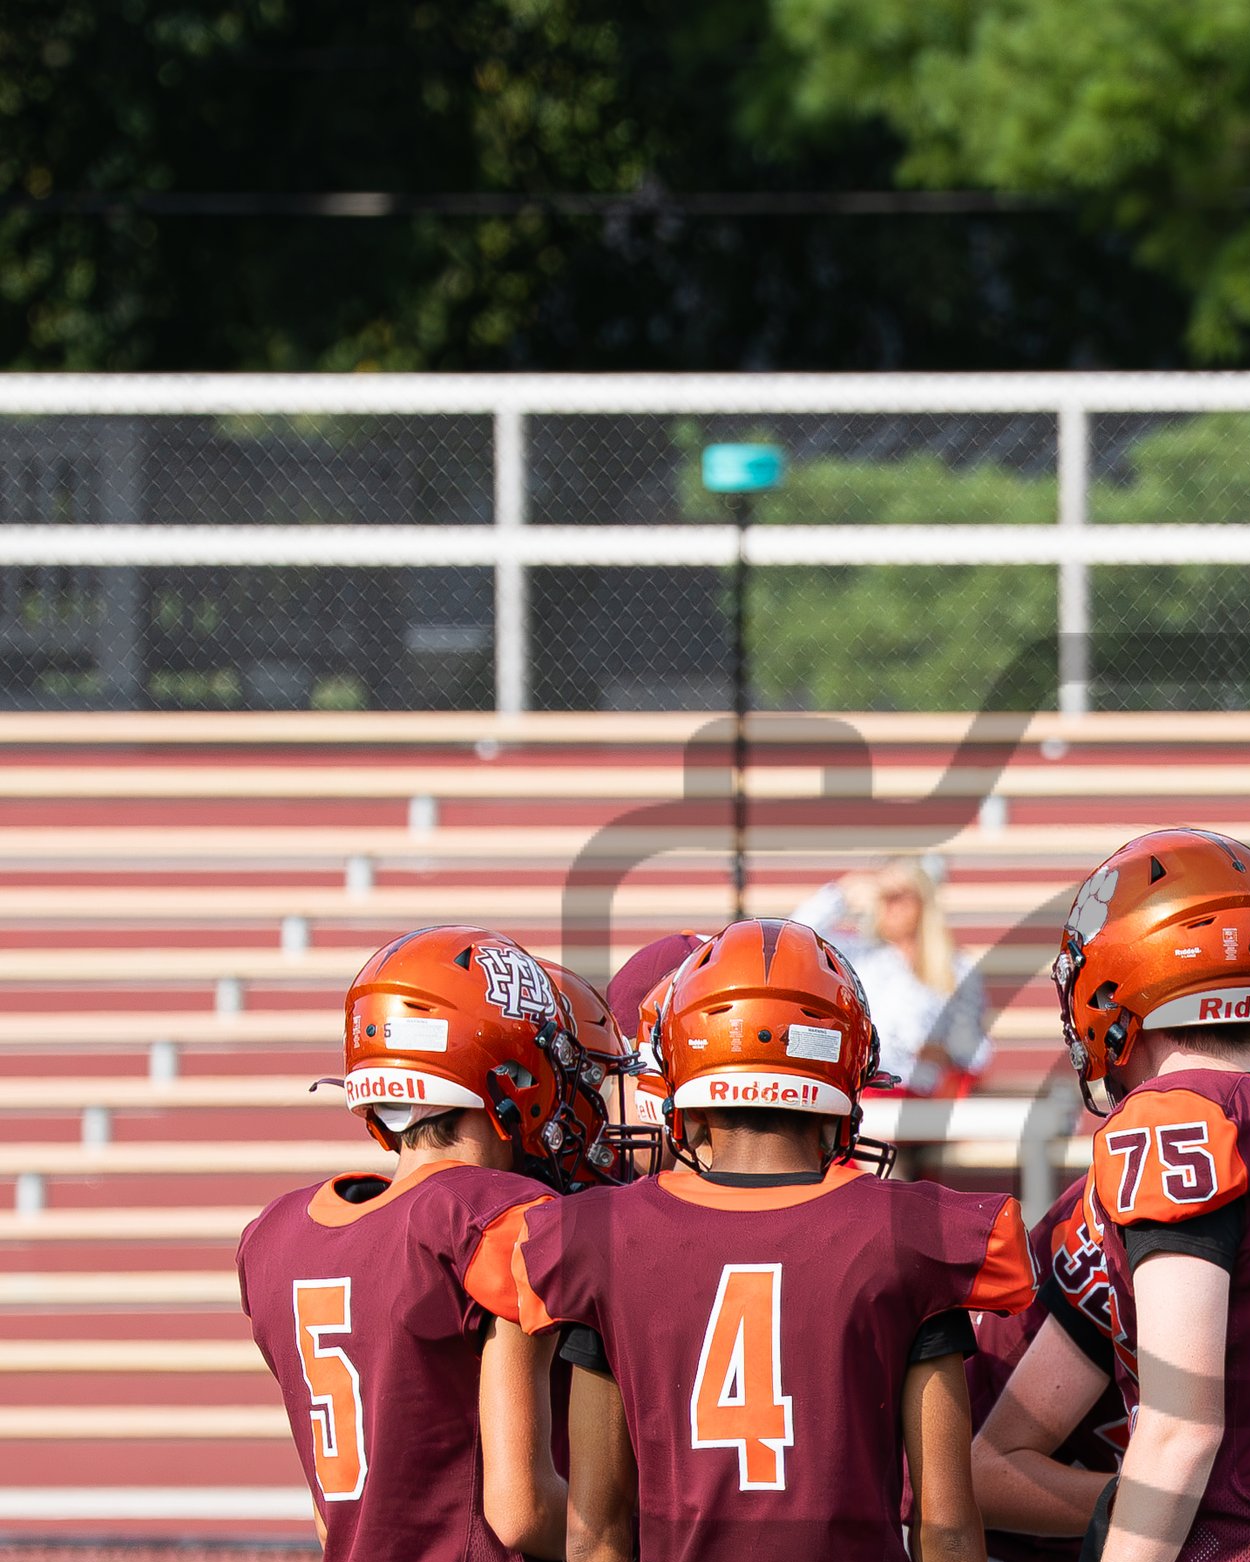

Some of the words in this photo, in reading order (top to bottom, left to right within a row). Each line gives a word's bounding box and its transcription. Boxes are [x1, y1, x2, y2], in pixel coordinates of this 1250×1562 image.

[346, 1076, 427, 1101] Riddell
[709, 1081, 820, 1105] Riddell
[1105, 1121, 1219, 1213] 75
[292, 1276, 369, 1503] 5
[690, 1262, 795, 1492] 4
